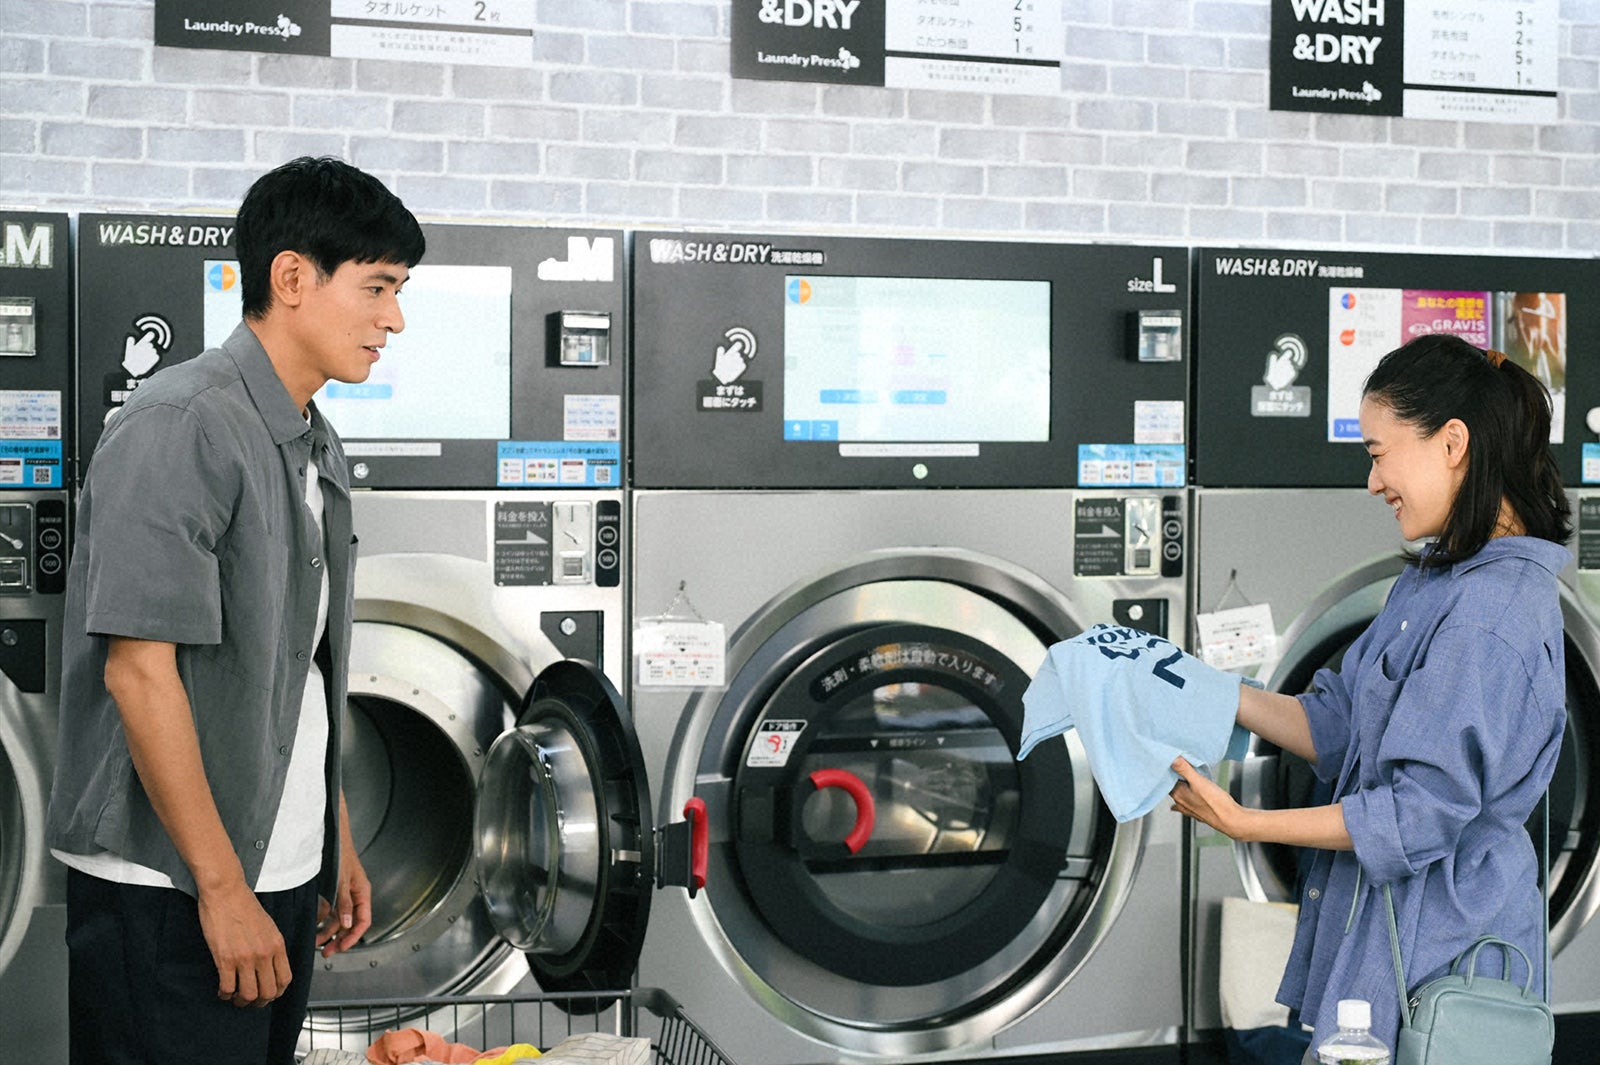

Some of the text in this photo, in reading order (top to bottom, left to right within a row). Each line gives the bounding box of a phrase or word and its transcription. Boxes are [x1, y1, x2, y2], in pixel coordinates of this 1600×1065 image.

[365, 1, 447, 18] タオルケット
[757, 0, 860, 30] &DRY
[1290, 0, 1385, 26] WASH
[184, 18, 280, 37] Laundry Press
[917, 15, 975, 28] タオルケット
[916, 36, 968, 49] こたつ布団
[1292, 33, 1383, 65] &DRY
[757, 51, 842, 69] Laundry Press
[1292, 86, 1365, 102] Laundry Press
[1431, 319, 1486, 332] GRAVIS
[716, 384, 744, 397] まずは
[1268, 391, 1294, 402] まずは
[703, 396, 757, 408] 画面にタッチ
[497, 511, 548, 522] 料金を投入
[1077, 506, 1121, 517] 料金を投入
[768, 722, 797, 731] ドア操作
